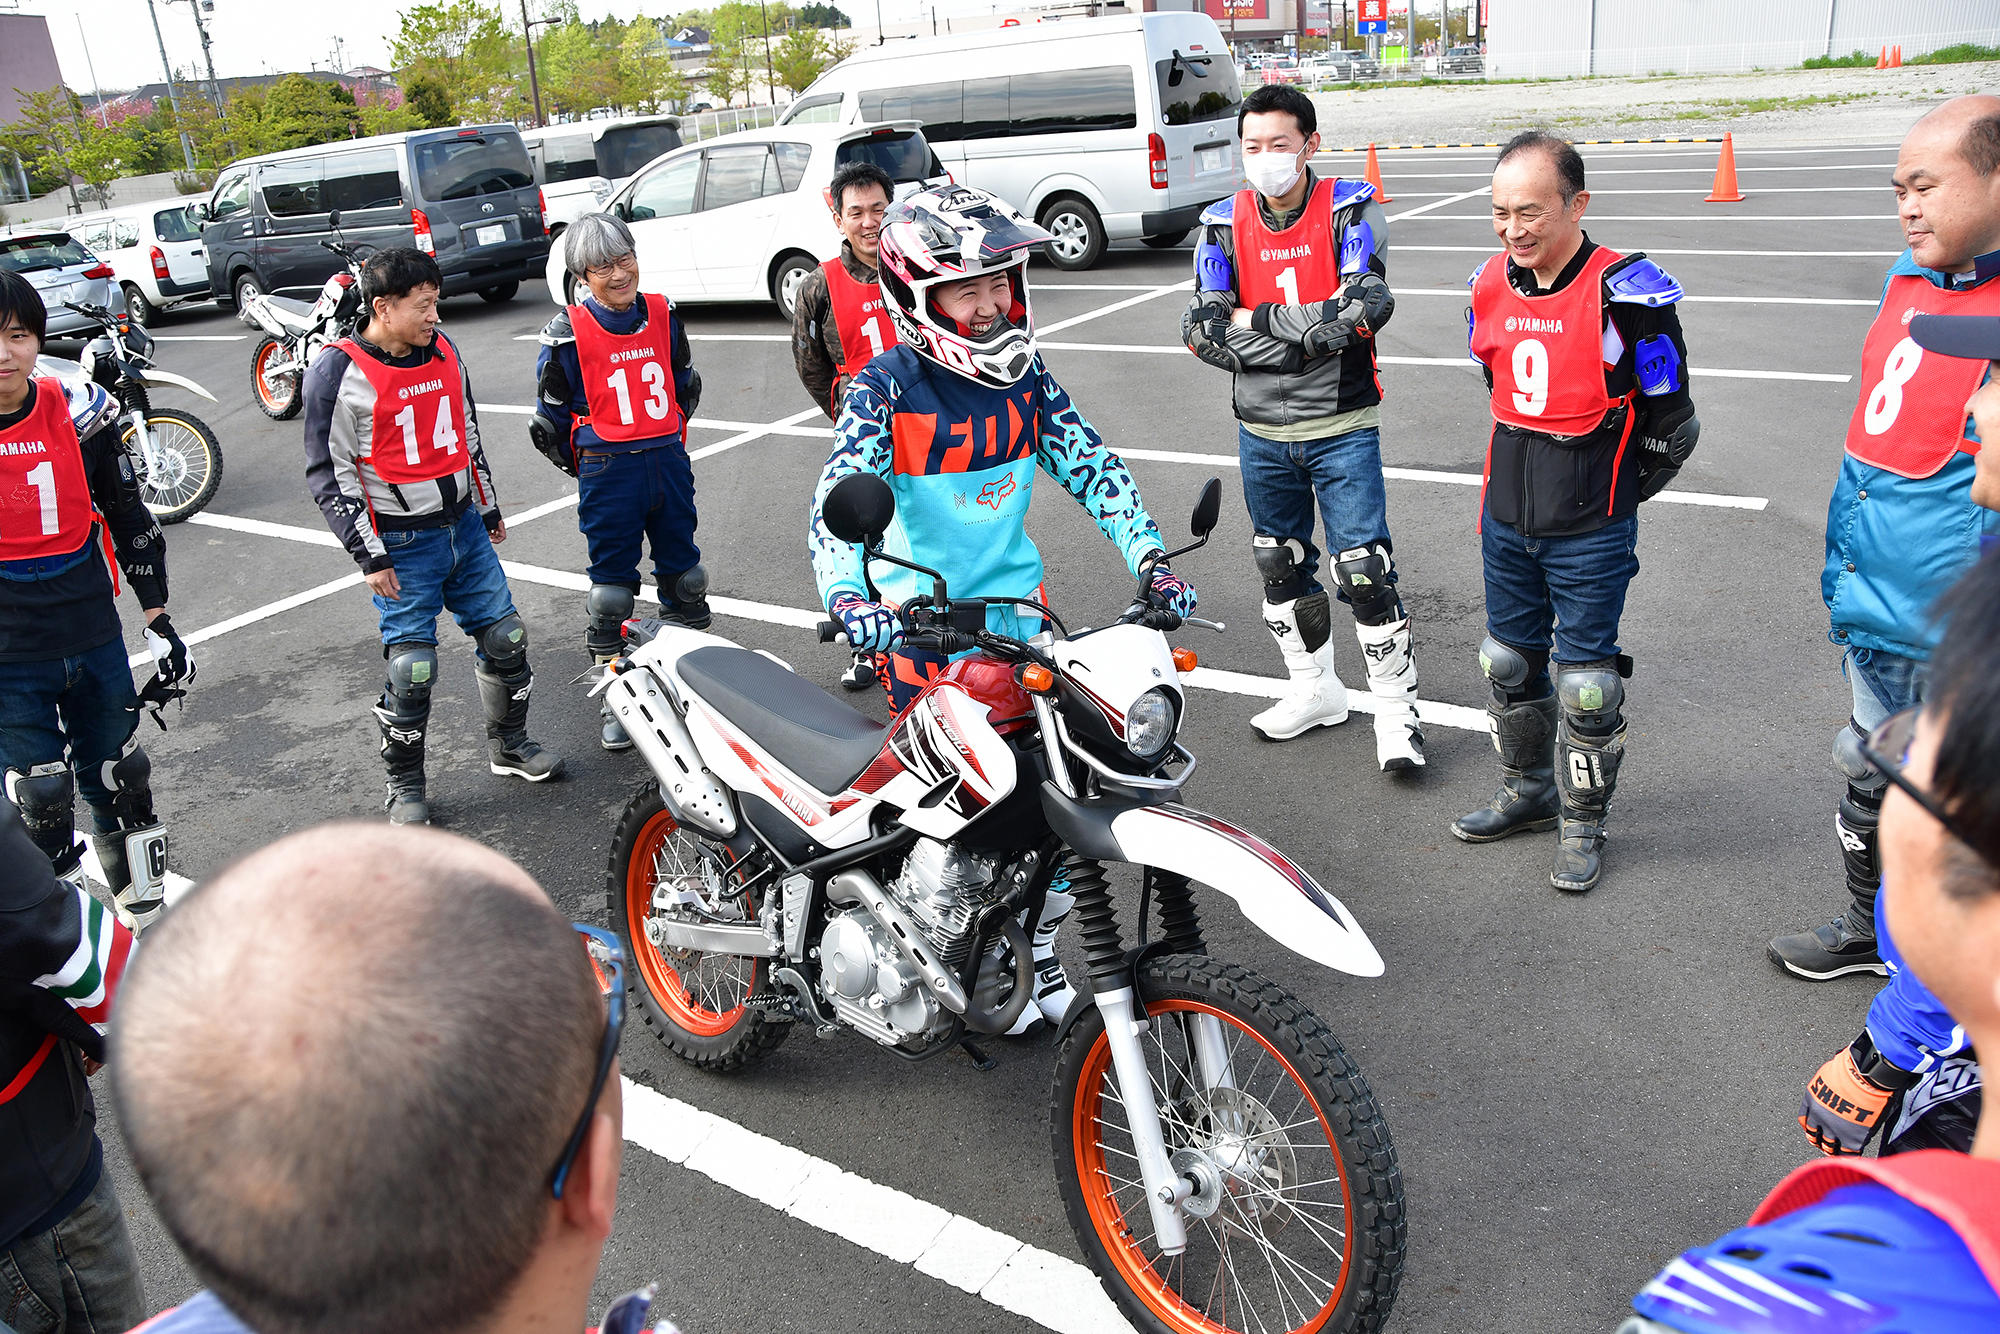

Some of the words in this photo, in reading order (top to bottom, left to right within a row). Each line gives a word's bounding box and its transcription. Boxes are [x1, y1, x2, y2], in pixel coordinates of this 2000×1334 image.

[1368, 22, 1377, 33] P
[1384, 32, 1393, 45] P
[946, 190, 985, 211] Arai
[1271, 244, 1311, 261] YAMAHA
[1276, 267, 1300, 306] 1
[890, 309, 922, 345] Arai
[1517, 317, 1563, 333] YAMAHA
[619, 347, 655, 362] YAMAHA
[918, 325, 979, 377] 10
[408, 379, 444, 397] YAMAHA
[607, 361, 669, 425] 13
[1512, 339, 1548, 416] 9
[1864, 336, 1924, 435] 8
[0, 440, 46, 456] AMAHA
[395, 395, 459, 466] 14
[924, 391, 1037, 475] FOX
[1645, 436, 1669, 453] YAM
[1569, 751, 1591, 789] G
[781, 789, 814, 825] YAMAHA
[1811, 1076, 1875, 1123] SHIFT
